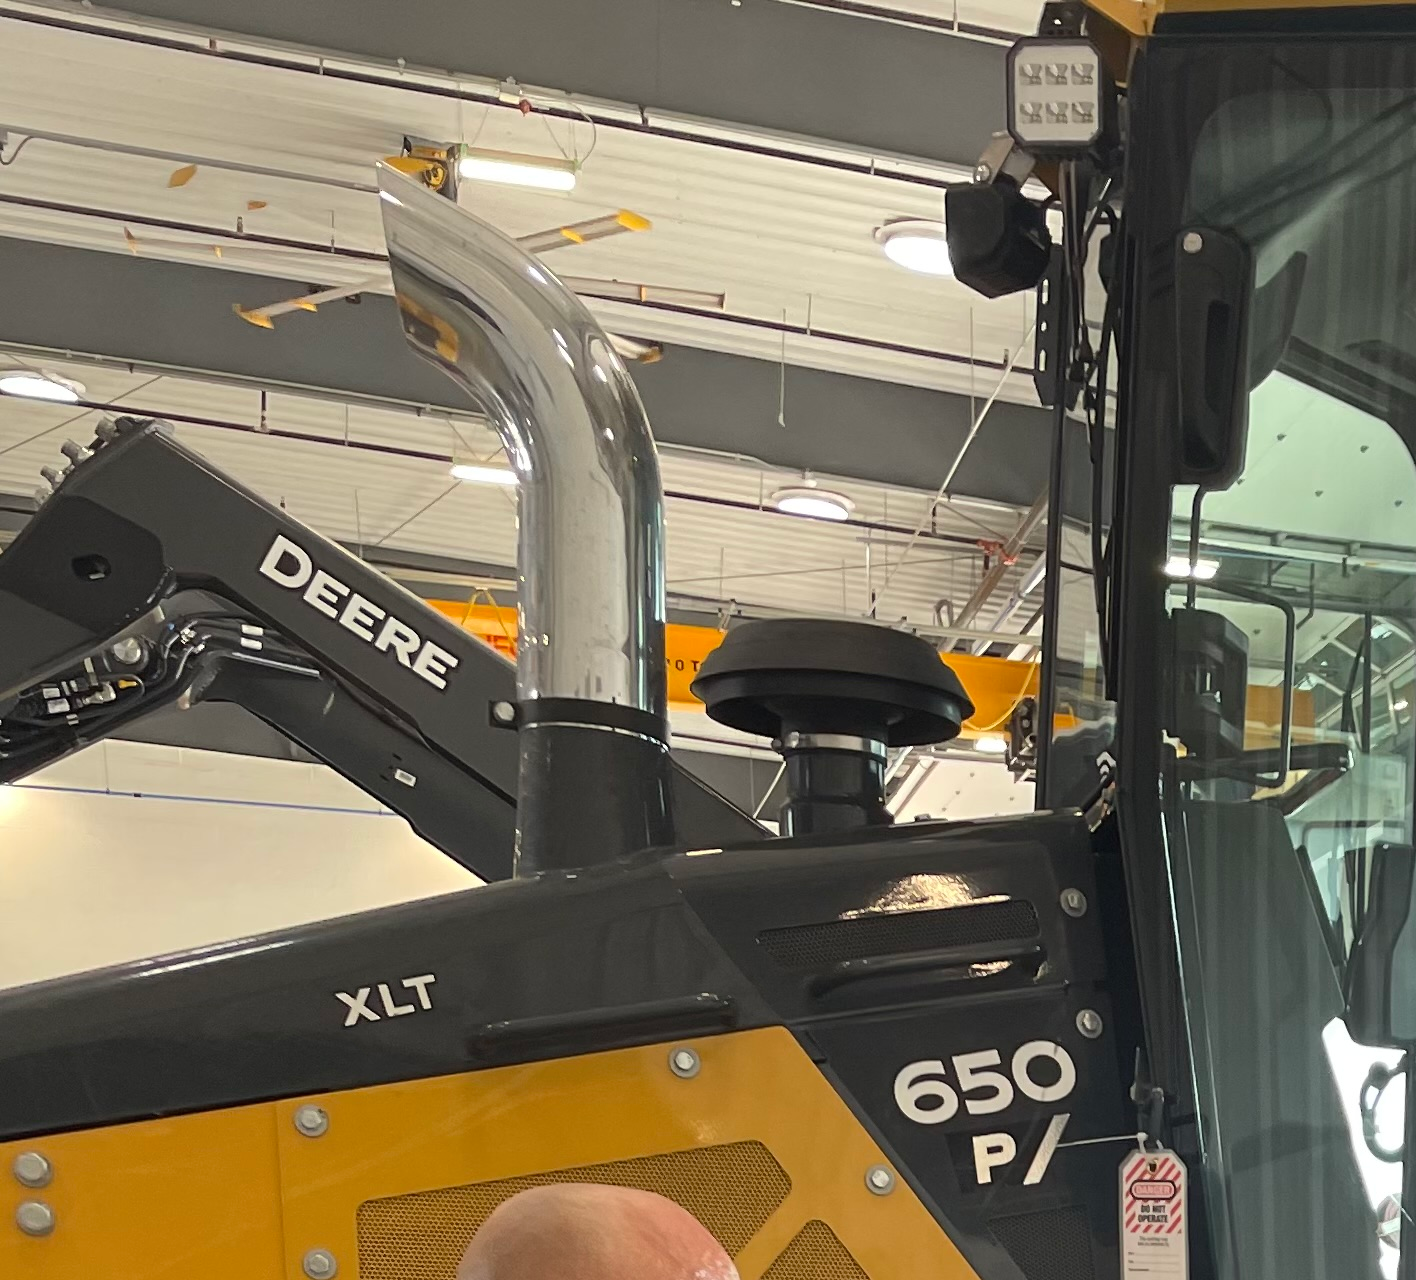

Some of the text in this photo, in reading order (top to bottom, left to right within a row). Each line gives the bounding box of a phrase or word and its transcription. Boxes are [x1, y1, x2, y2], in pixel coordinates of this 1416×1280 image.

[260, 534, 459, 690] DEERE
[335, 974, 436, 1027] XLT
[893, 1039, 1077, 1125] 650
